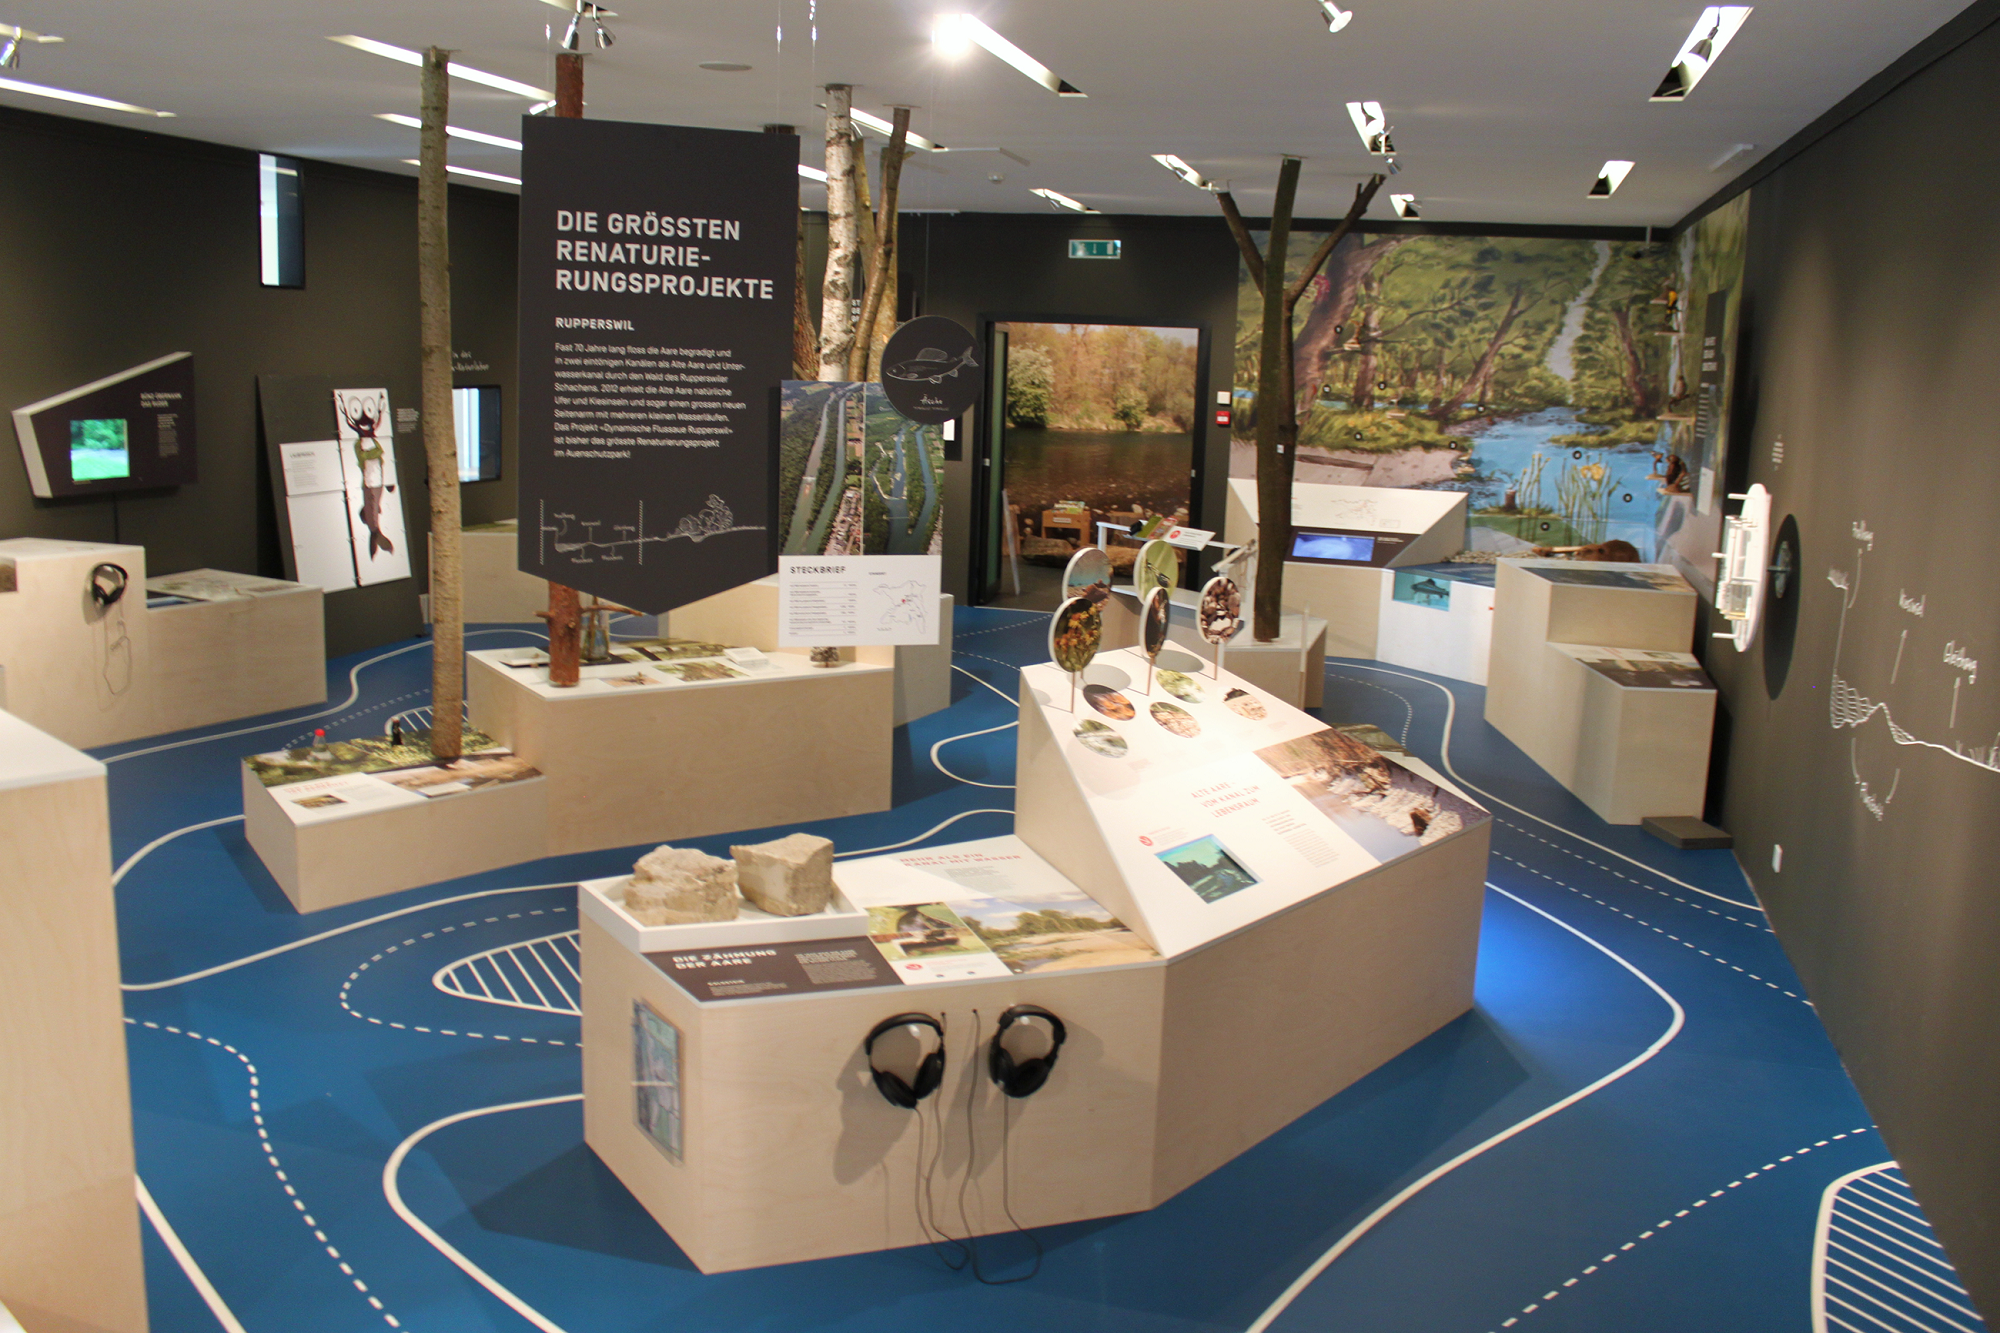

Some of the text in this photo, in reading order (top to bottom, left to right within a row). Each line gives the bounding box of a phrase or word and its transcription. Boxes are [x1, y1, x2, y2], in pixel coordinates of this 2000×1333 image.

[556, 210, 740, 241] DIE GRÖSSTEN
[556, 240, 711, 267] RENATURIE-
[555, 269, 774, 300] RUNGSPROJEKTE
[555, 317, 635, 332] RUPPERSWIL
[555, 342, 732, 358] Fast 70 Jahre lang floss die Aare begradigt und
[555, 356, 563, 365] in
[563, 357, 583, 366] zwei
[657, 360, 670, 369] als
[671, 360, 686, 369] Alte
[687, 361, 705, 370] Aare
[706, 362, 721, 370] und
[721, 362, 746, 371] Unter-
[554, 370, 729, 384] wasserkanal durch den Wald des Rupperswiler
[600, 383, 619, 393] 2012
[619, 384, 645, 394] erhielt
[645, 385, 658, 394] die
[658, 385, 674, 395] Alte
[674, 386, 693, 395] Aare
[693, 387, 732, 397] natürliche
[554, 396, 746, 410] Ufer und Kiesinseln und sogar einen grossen neuen
[554, 409, 595, 419] Seitenarm
[595, 410, 609, 419] mit
[609, 410, 648, 420] mehreren
[648, 411, 677, 421] kleinen
[554, 422, 570, 432] Das
[570, 422, 599, 434] Projekt
[652, 424, 687, 434] Flussaue
[554, 435, 565, 445] ist
[565, 435, 590, 445] bisher
[590, 436, 605, 446] das
[605, 437, 636, 447] grösste
[554, 448, 565, 458] im
[790, 566, 846, 574] STECKBRIEF
[1191, 788, 1211, 798] ALTE
[1210, 782, 1232, 792] AARE
[1200, 785, 1260, 808] VOM KANAL ZUM
[1210, 798, 1260, 818] LEBENSRAUM
[672, 949, 777, 963] DIE ZÄHMUNG
[675, 958, 752, 970] DER AARE
